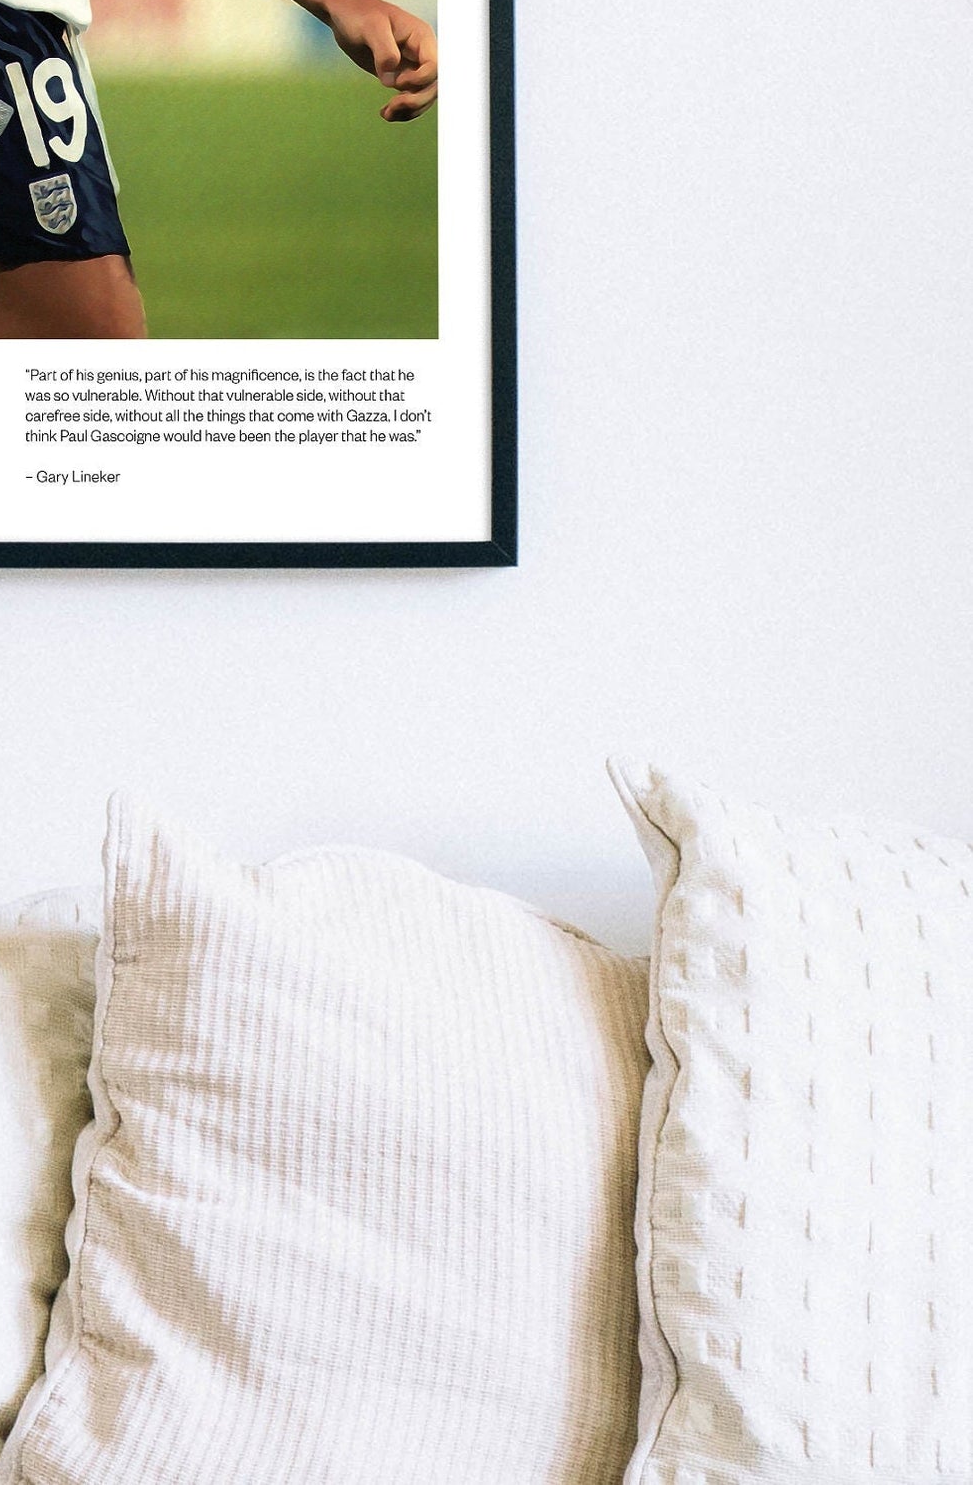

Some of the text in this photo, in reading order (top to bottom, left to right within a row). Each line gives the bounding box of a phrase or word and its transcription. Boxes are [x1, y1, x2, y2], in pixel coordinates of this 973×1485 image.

[6, 58, 87, 168] 19
[60, 369, 74, 381] of
[76, 369, 94, 381] his
[97, 369, 142, 384] genius,
[145, 371, 171, 383] part
[175, 369, 188, 381] of
[191, 369, 209, 381] his
[212, 369, 301, 384] magnificence,
[305, 369, 315, 381] is
[318, 369, 338, 381] the
[341, 369, 366, 381] fact
[370, 369, 395, 381] that
[398, 369, 414, 381] he
[25, 389, 405, 402] was so vulnerable. Without that vulnerable side, without that
[26, 409, 80, 422] carefree
[83, 409, 112, 422] side,
[115, 409, 163, 422] without
[166, 409, 179, 422] all
[184, 409, 204, 422] the
[207, 409, 245, 424] things
[249, 409, 274, 422] that
[277, 412, 314, 422] come
[317, 410, 343, 422] with
[347, 409, 390, 422] Gazza,
[26, 429, 57, 442] think
[61, 429, 87, 442] Paul
[91, 430, 160, 444] Gascoigne
[163, 430, 201, 442] would
[205, 430, 235, 442] have
[240, 430, 270, 442] been
[275, 430, 295, 442] the
[299, 430, 338, 444] player
[342, 430, 367, 442] that
[370, 430, 386, 442] he
[37, 470, 68, 485] Gary
[73, 470, 120, 483] Lineker
